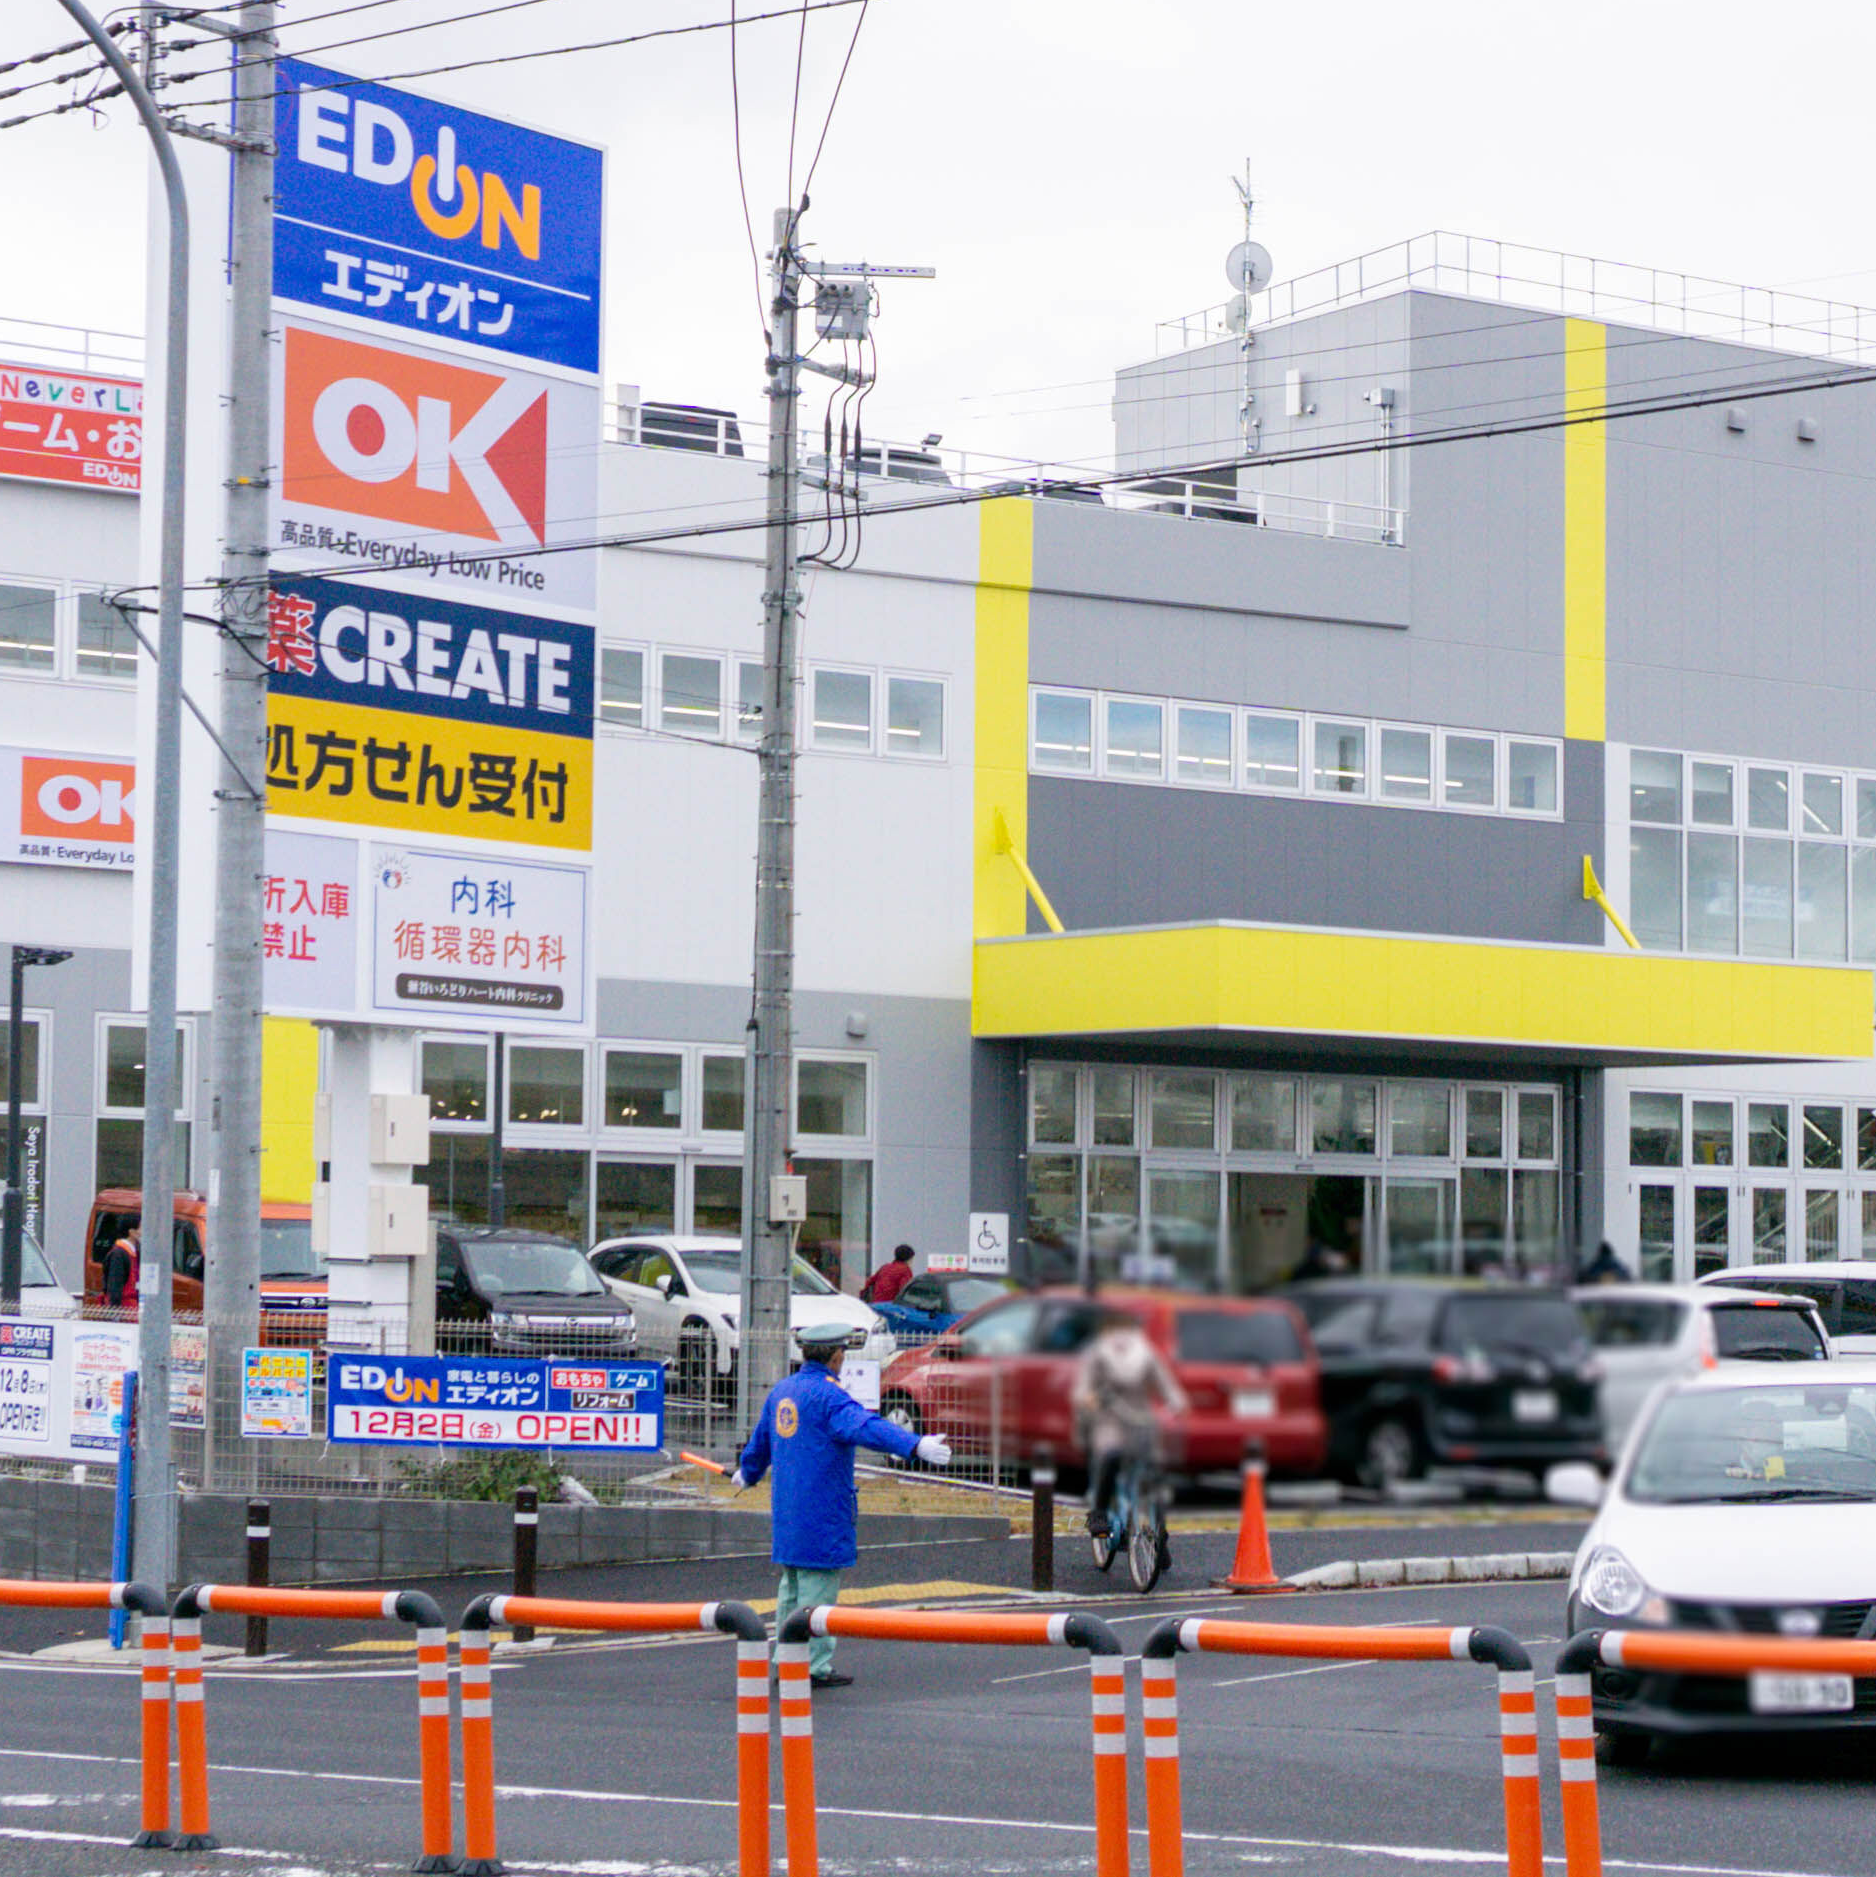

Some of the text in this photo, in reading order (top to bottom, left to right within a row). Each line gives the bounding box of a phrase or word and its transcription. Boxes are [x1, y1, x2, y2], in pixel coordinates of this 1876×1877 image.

[298, 83, 541, 261] EDION
[322, 249, 514, 336] エディオン
[82, 462, 138, 488] EDION
[312, 376, 548, 546] OK
[450, 550, 491, 580] Low
[499, 561, 544, 590] Price
[121, 851, 135, 864] Lo
[262, 877, 350, 920] 折入庫
[451, 875, 516, 919] 内科
[393, 920, 567, 974] 循環器内科
[340, 1365, 440, 1403] EDION
[446, 1385, 540, 1406] エディオン
[555, 1372, 604, 1388] おもちゃ
[615, 1372, 649, 1388] ゲーム
[577, 1393, 630, 1409] リフォーム
[517, 1414, 641, 1443] OPEN!!
